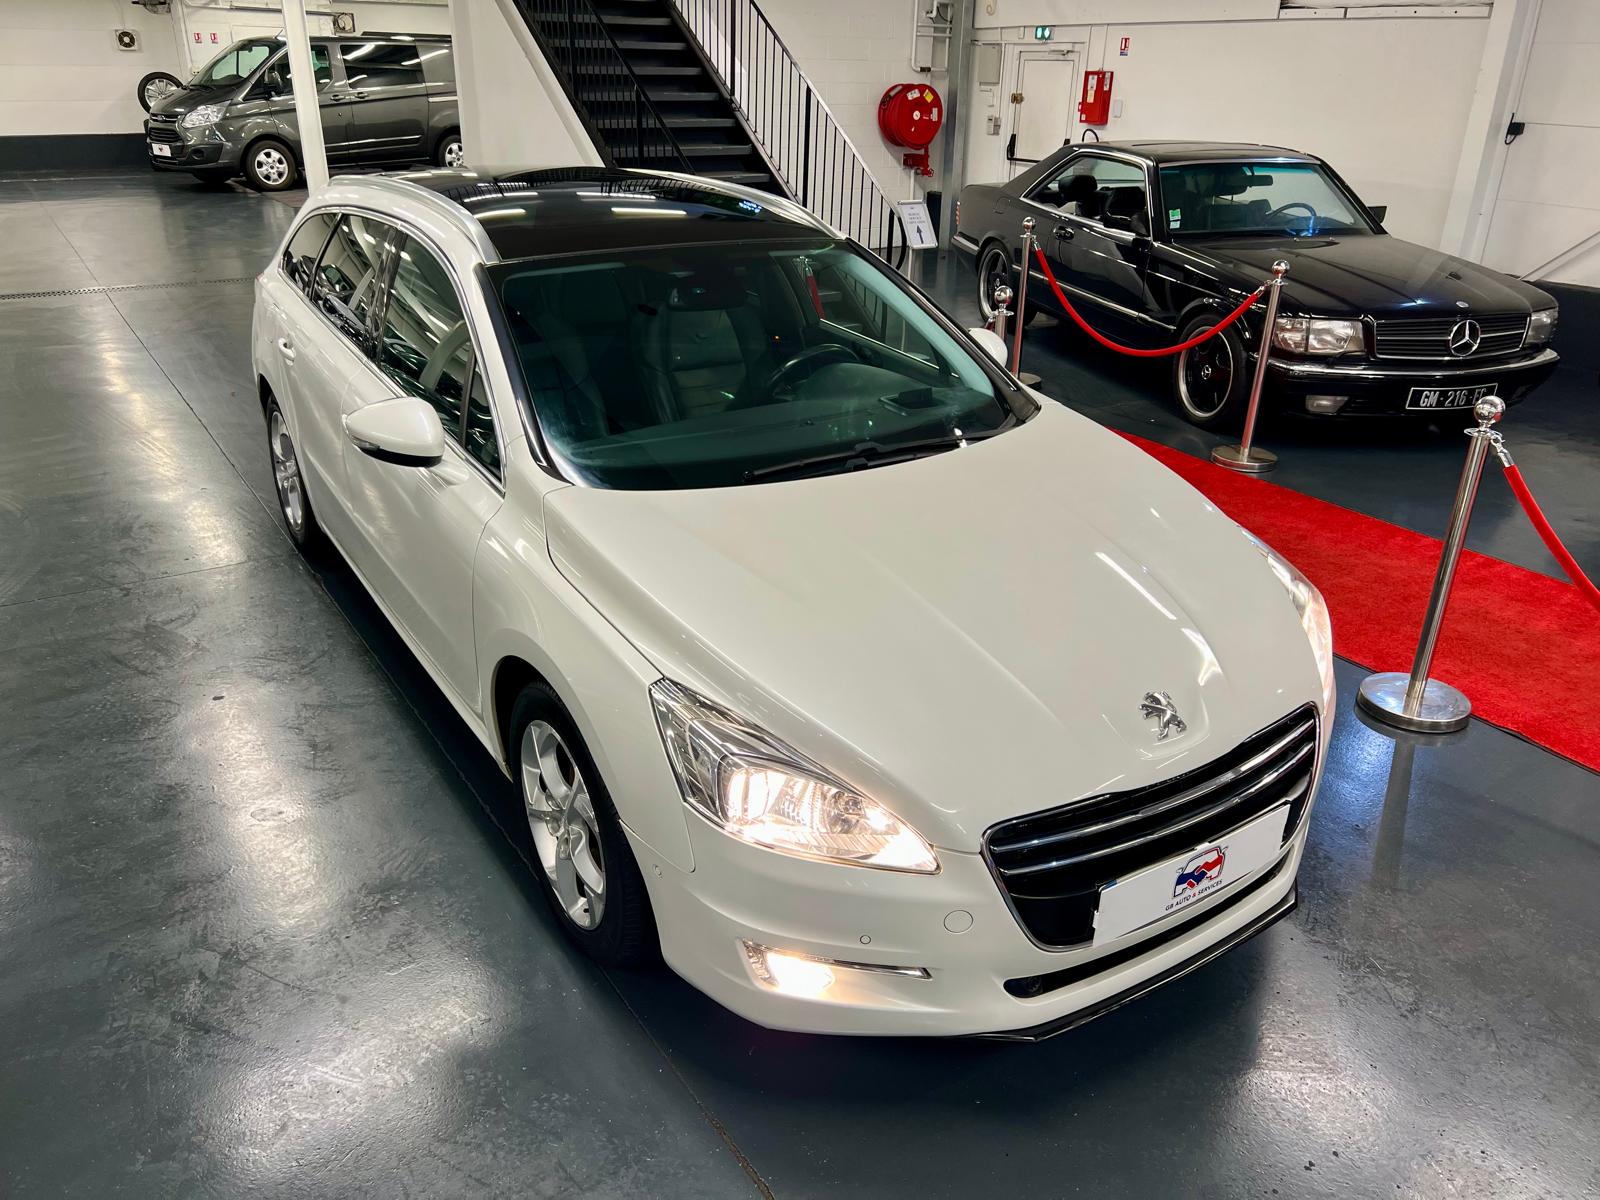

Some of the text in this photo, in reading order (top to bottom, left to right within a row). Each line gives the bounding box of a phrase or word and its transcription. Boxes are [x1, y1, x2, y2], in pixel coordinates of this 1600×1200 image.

[1165, 903, 1174, 911] GB
[1175, 895, 1191, 907] AUTO
[1198, 879, 1222, 895] SERVICES
